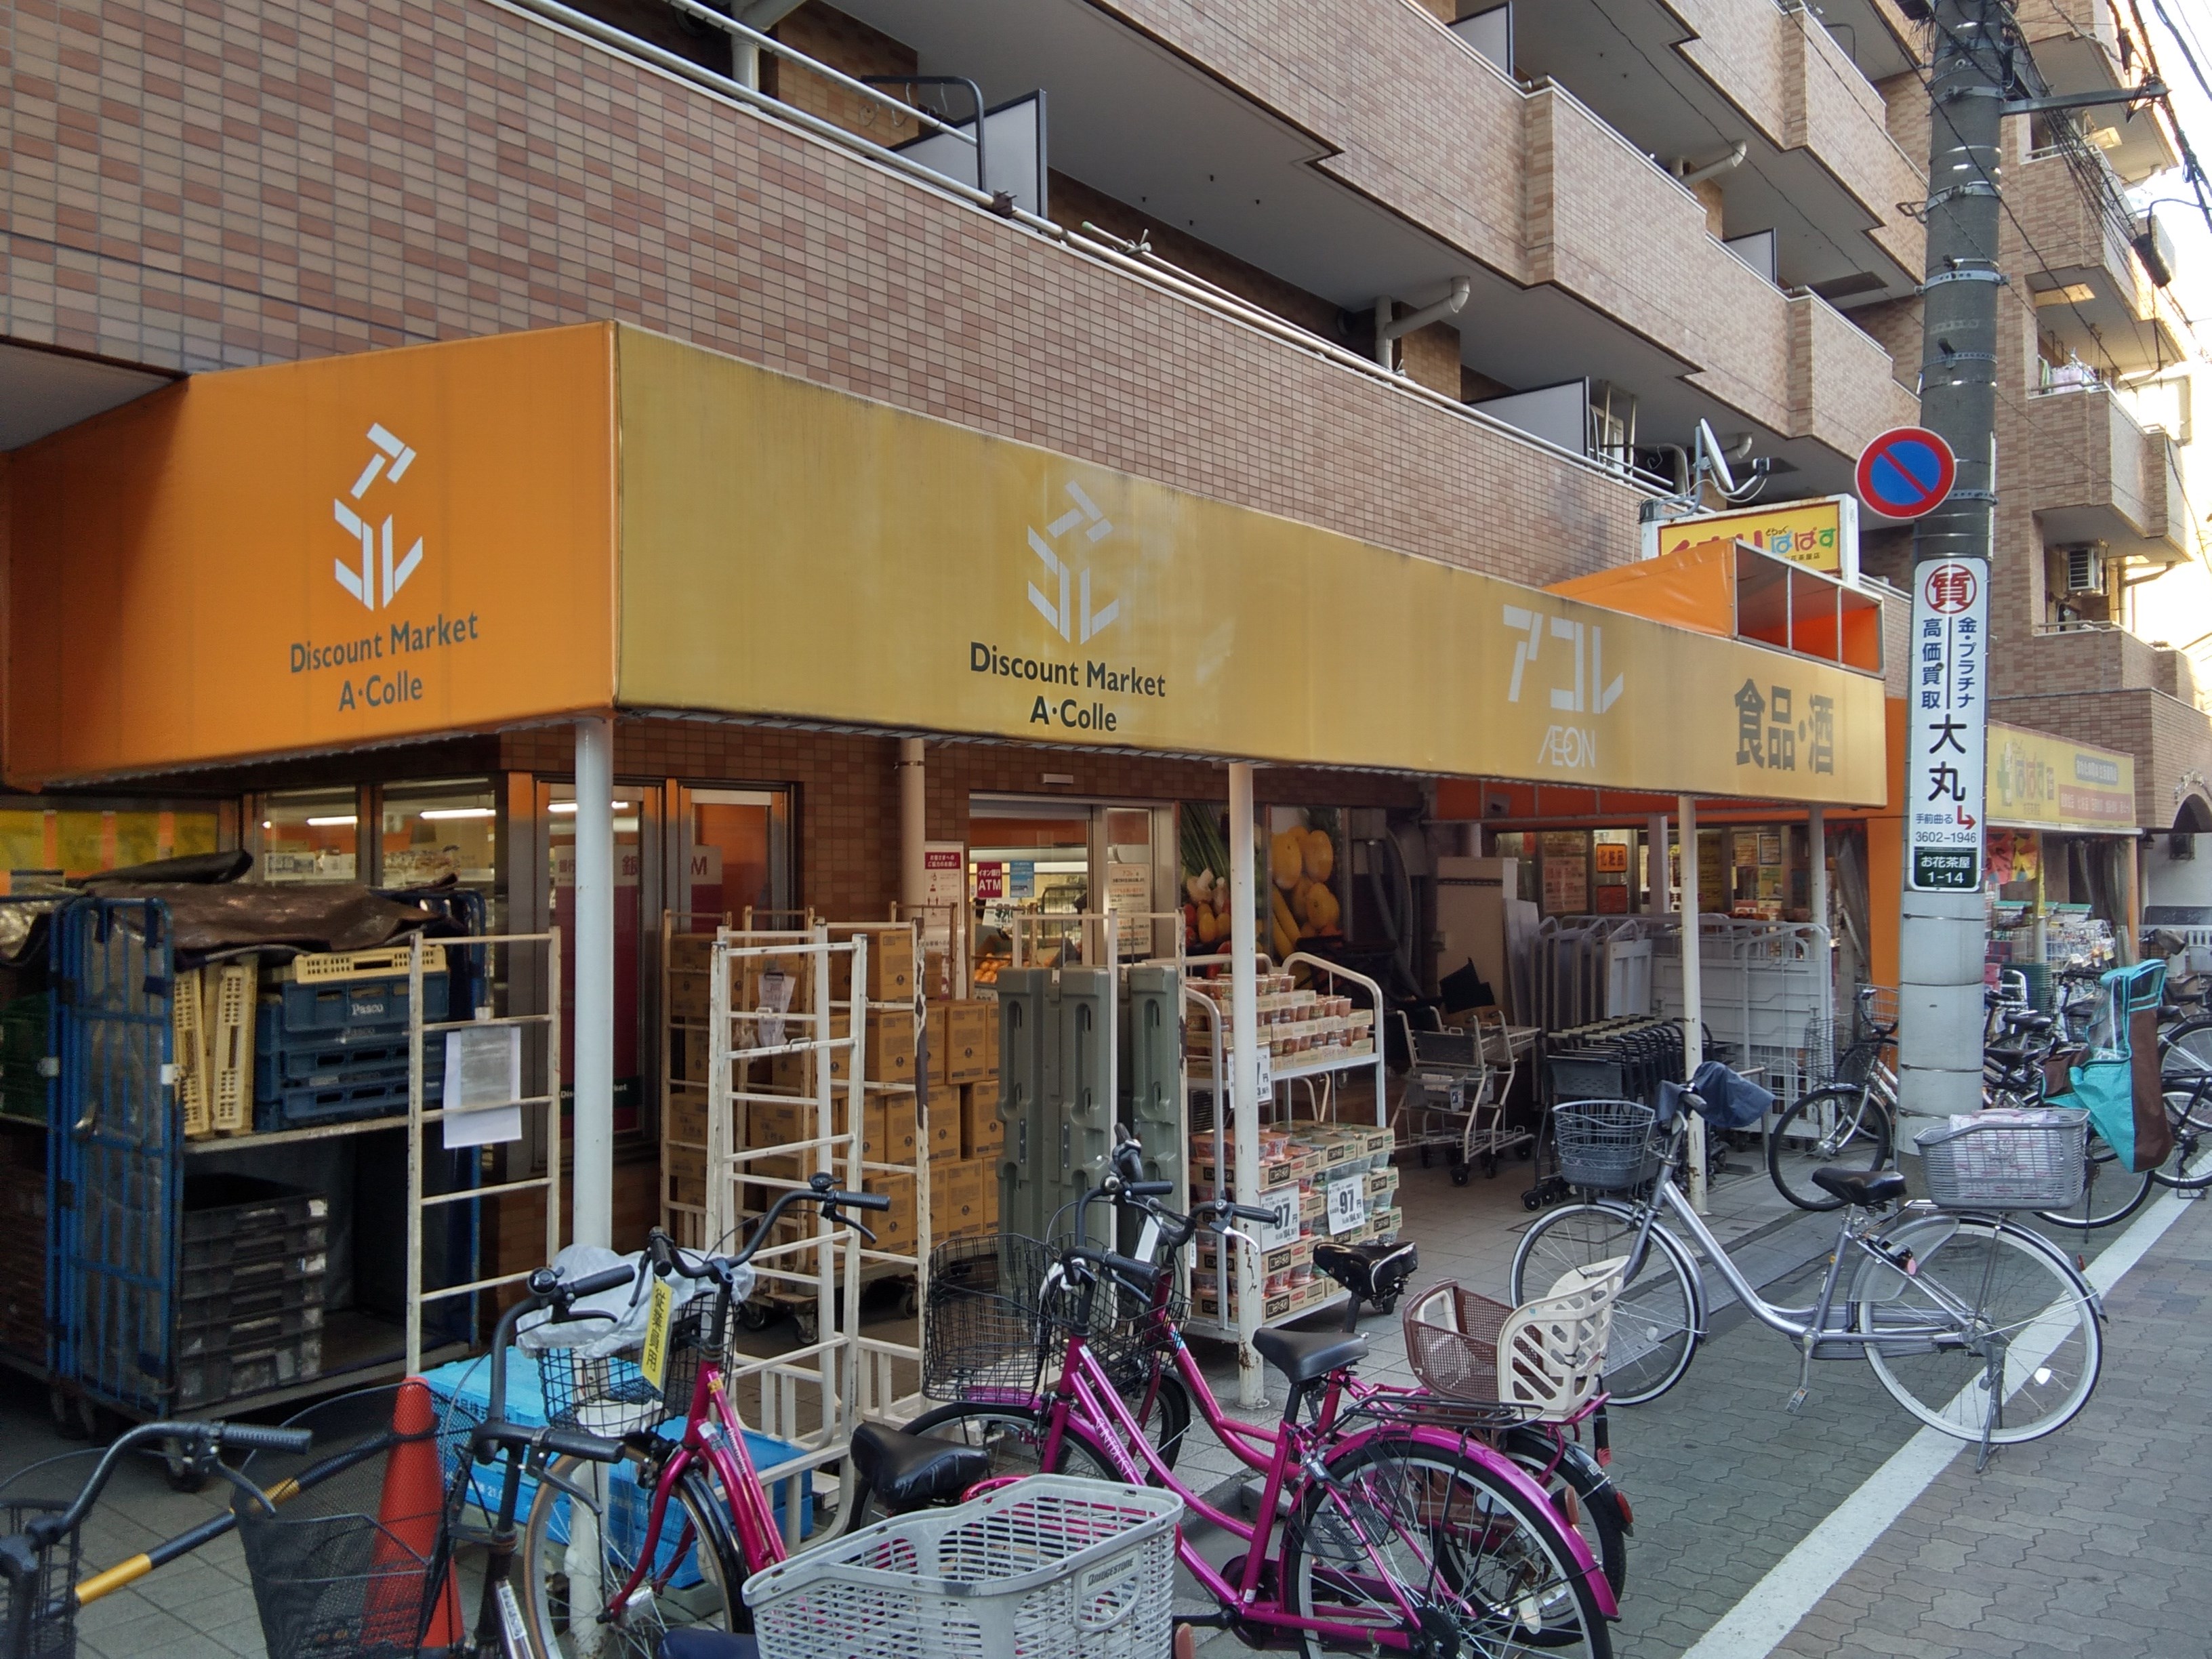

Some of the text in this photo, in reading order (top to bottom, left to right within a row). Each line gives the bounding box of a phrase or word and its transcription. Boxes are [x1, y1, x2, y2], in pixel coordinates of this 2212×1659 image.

[1931, 572, 1973, 610] 質
[290, 611, 479, 674] Discount Market
[1502, 603, 1624, 714] アコレ
[970, 640, 1166, 697] Discount Market
[1921, 617, 1944, 710] 高価買取
[1957, 617, 1978, 710] 金・プラチナ
[1734, 678, 1835, 775] 食品・酒
[1928, 714, 1968, 802] 大丸
[1915, 813, 1953, 825] 手前曲る
[1915, 832, 1977, 844] 3602-1946
[1921, 855, 1971, 869] お花茶屋
[1927, 872, 1965, 884] 1-14
[978, 879, 1001, 891] ATM
[352, 1003, 384, 1015] Pasco
[1339, 1189, 1354, 1214] 97
[1087, 1557, 1135, 1587] BRIDGESTONE
